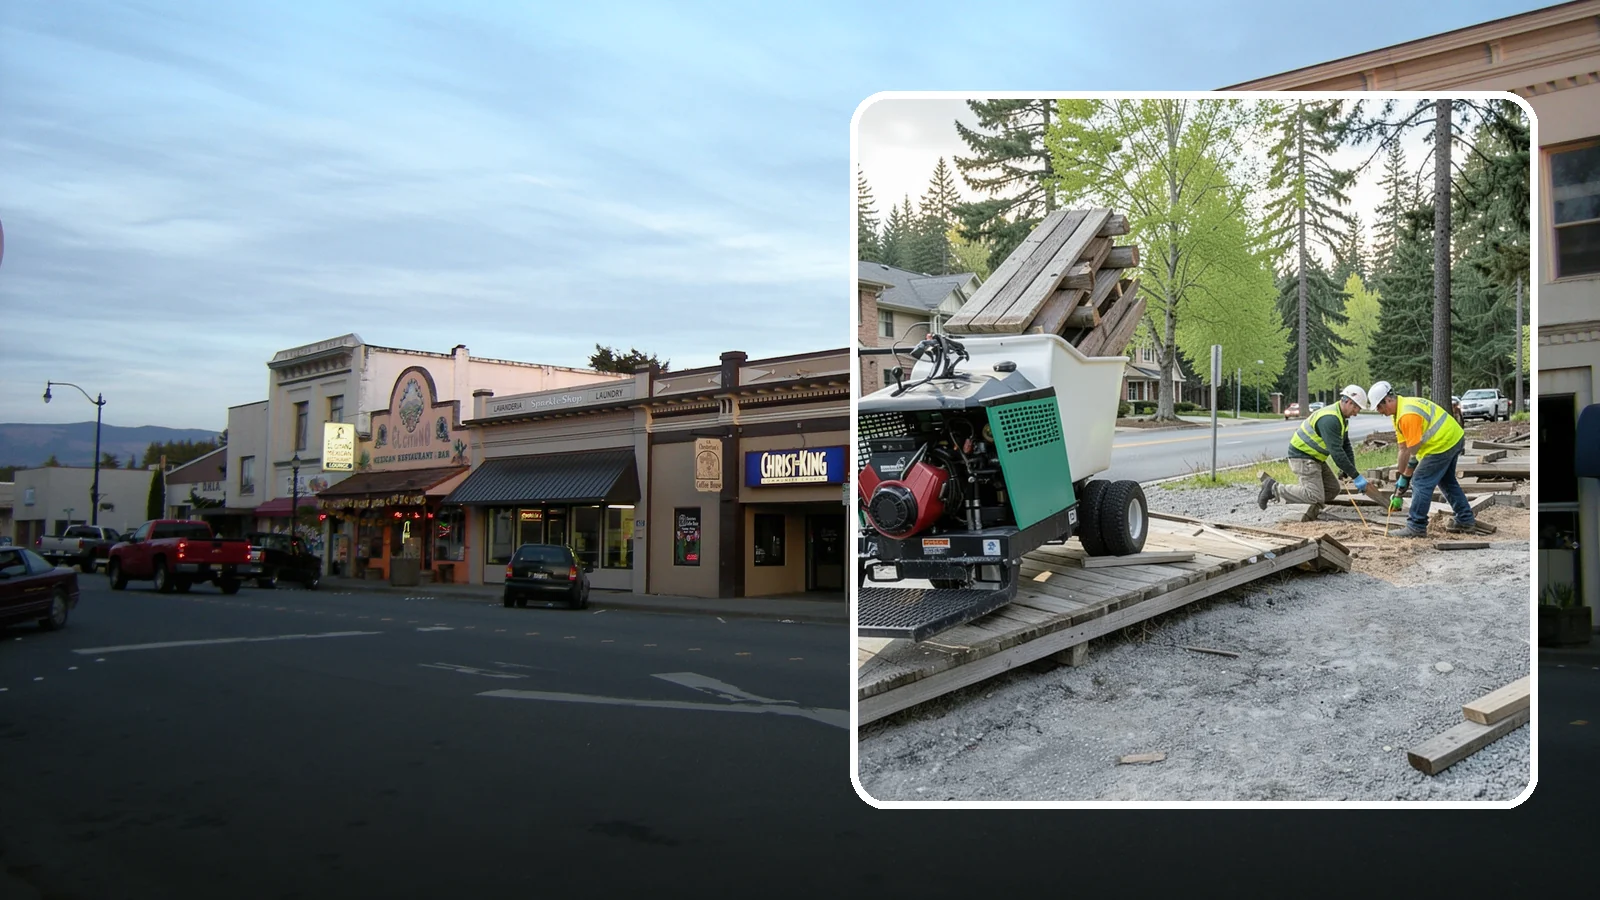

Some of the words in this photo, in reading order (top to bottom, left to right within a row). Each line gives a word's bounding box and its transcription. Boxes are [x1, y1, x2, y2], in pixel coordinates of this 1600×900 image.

[494, 402, 522, 412] LAVANDERIA
[531, 397, 561, 408] Sparkle
[562, 394, 582, 405] Shop
[595, 389, 624, 399] LAUNDRY
[374, 455, 396, 463] MEXICAN
[398, 451, 433, 462] RESTAURANT
[437, 450, 450, 459] BAR
[761, 452, 797, 478] CHRIST
[799, 450, 827, 476] KING
[696, 481, 709, 489] Coffee
[710, 481, 721, 489] House
